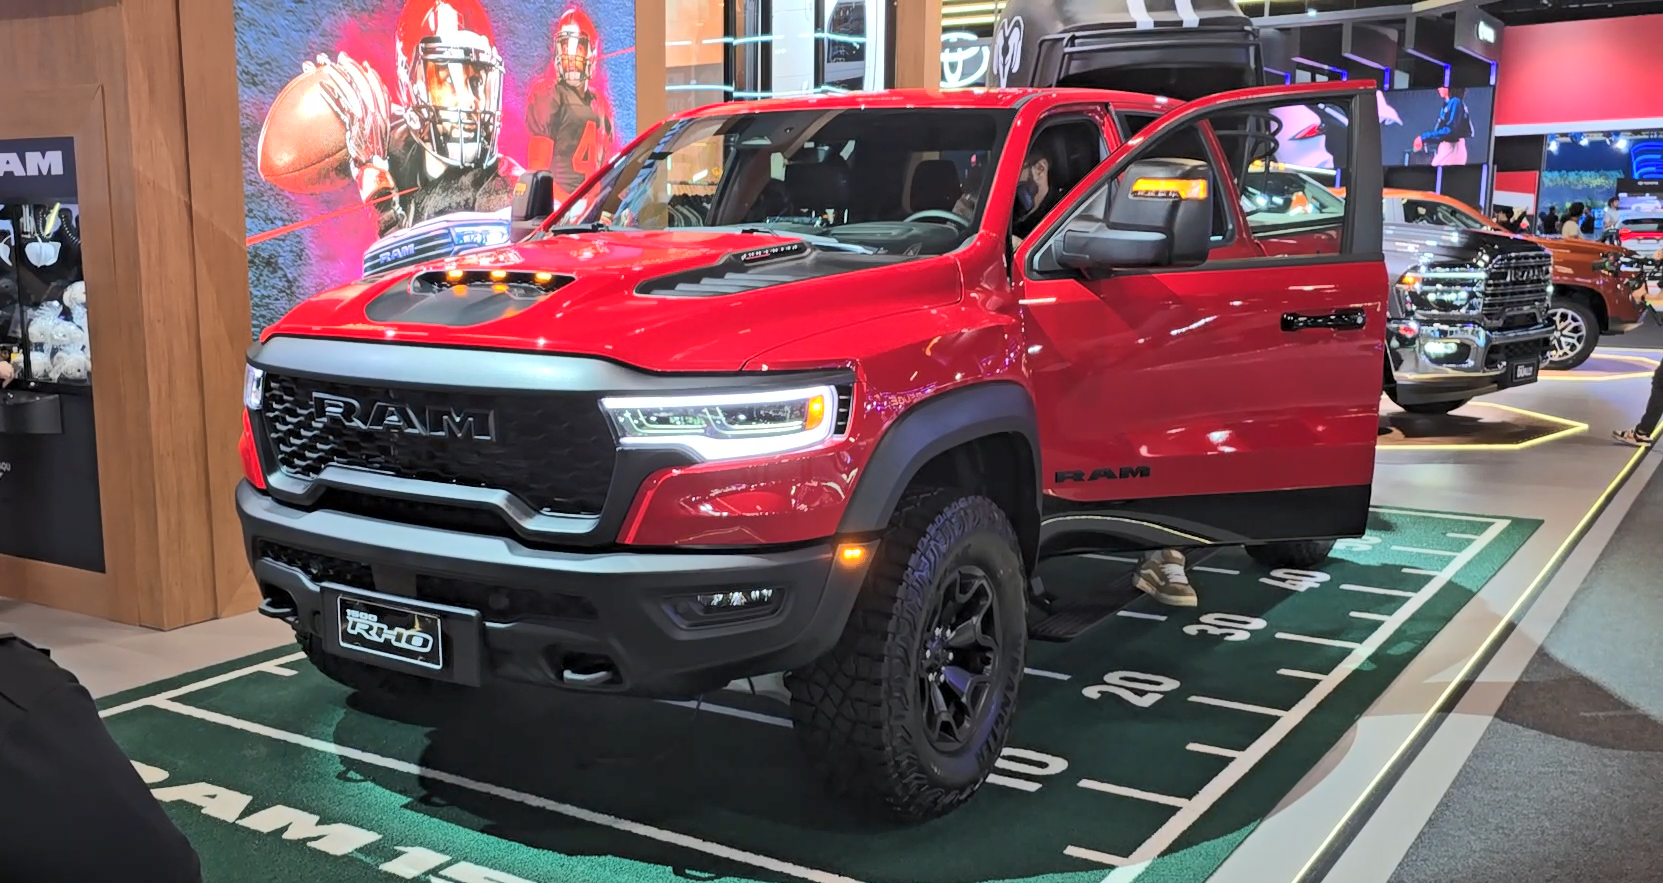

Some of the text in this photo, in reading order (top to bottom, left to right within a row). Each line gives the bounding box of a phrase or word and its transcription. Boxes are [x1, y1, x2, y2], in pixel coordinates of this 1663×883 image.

[0, 150, 63, 176] AM
[379, 243, 416, 264] RAM
[312, 391, 496, 442] RAM
[1055, 466, 1150, 483] RAM
[1259, 568, 1331, 592] 40
[346, 608, 377, 622] 1500
[1183, 612, 1267, 641] 30
[346, 615, 434, 653] RHO
[1082, 670, 1181, 707] 20
[985, 747, 1069, 793] 10
